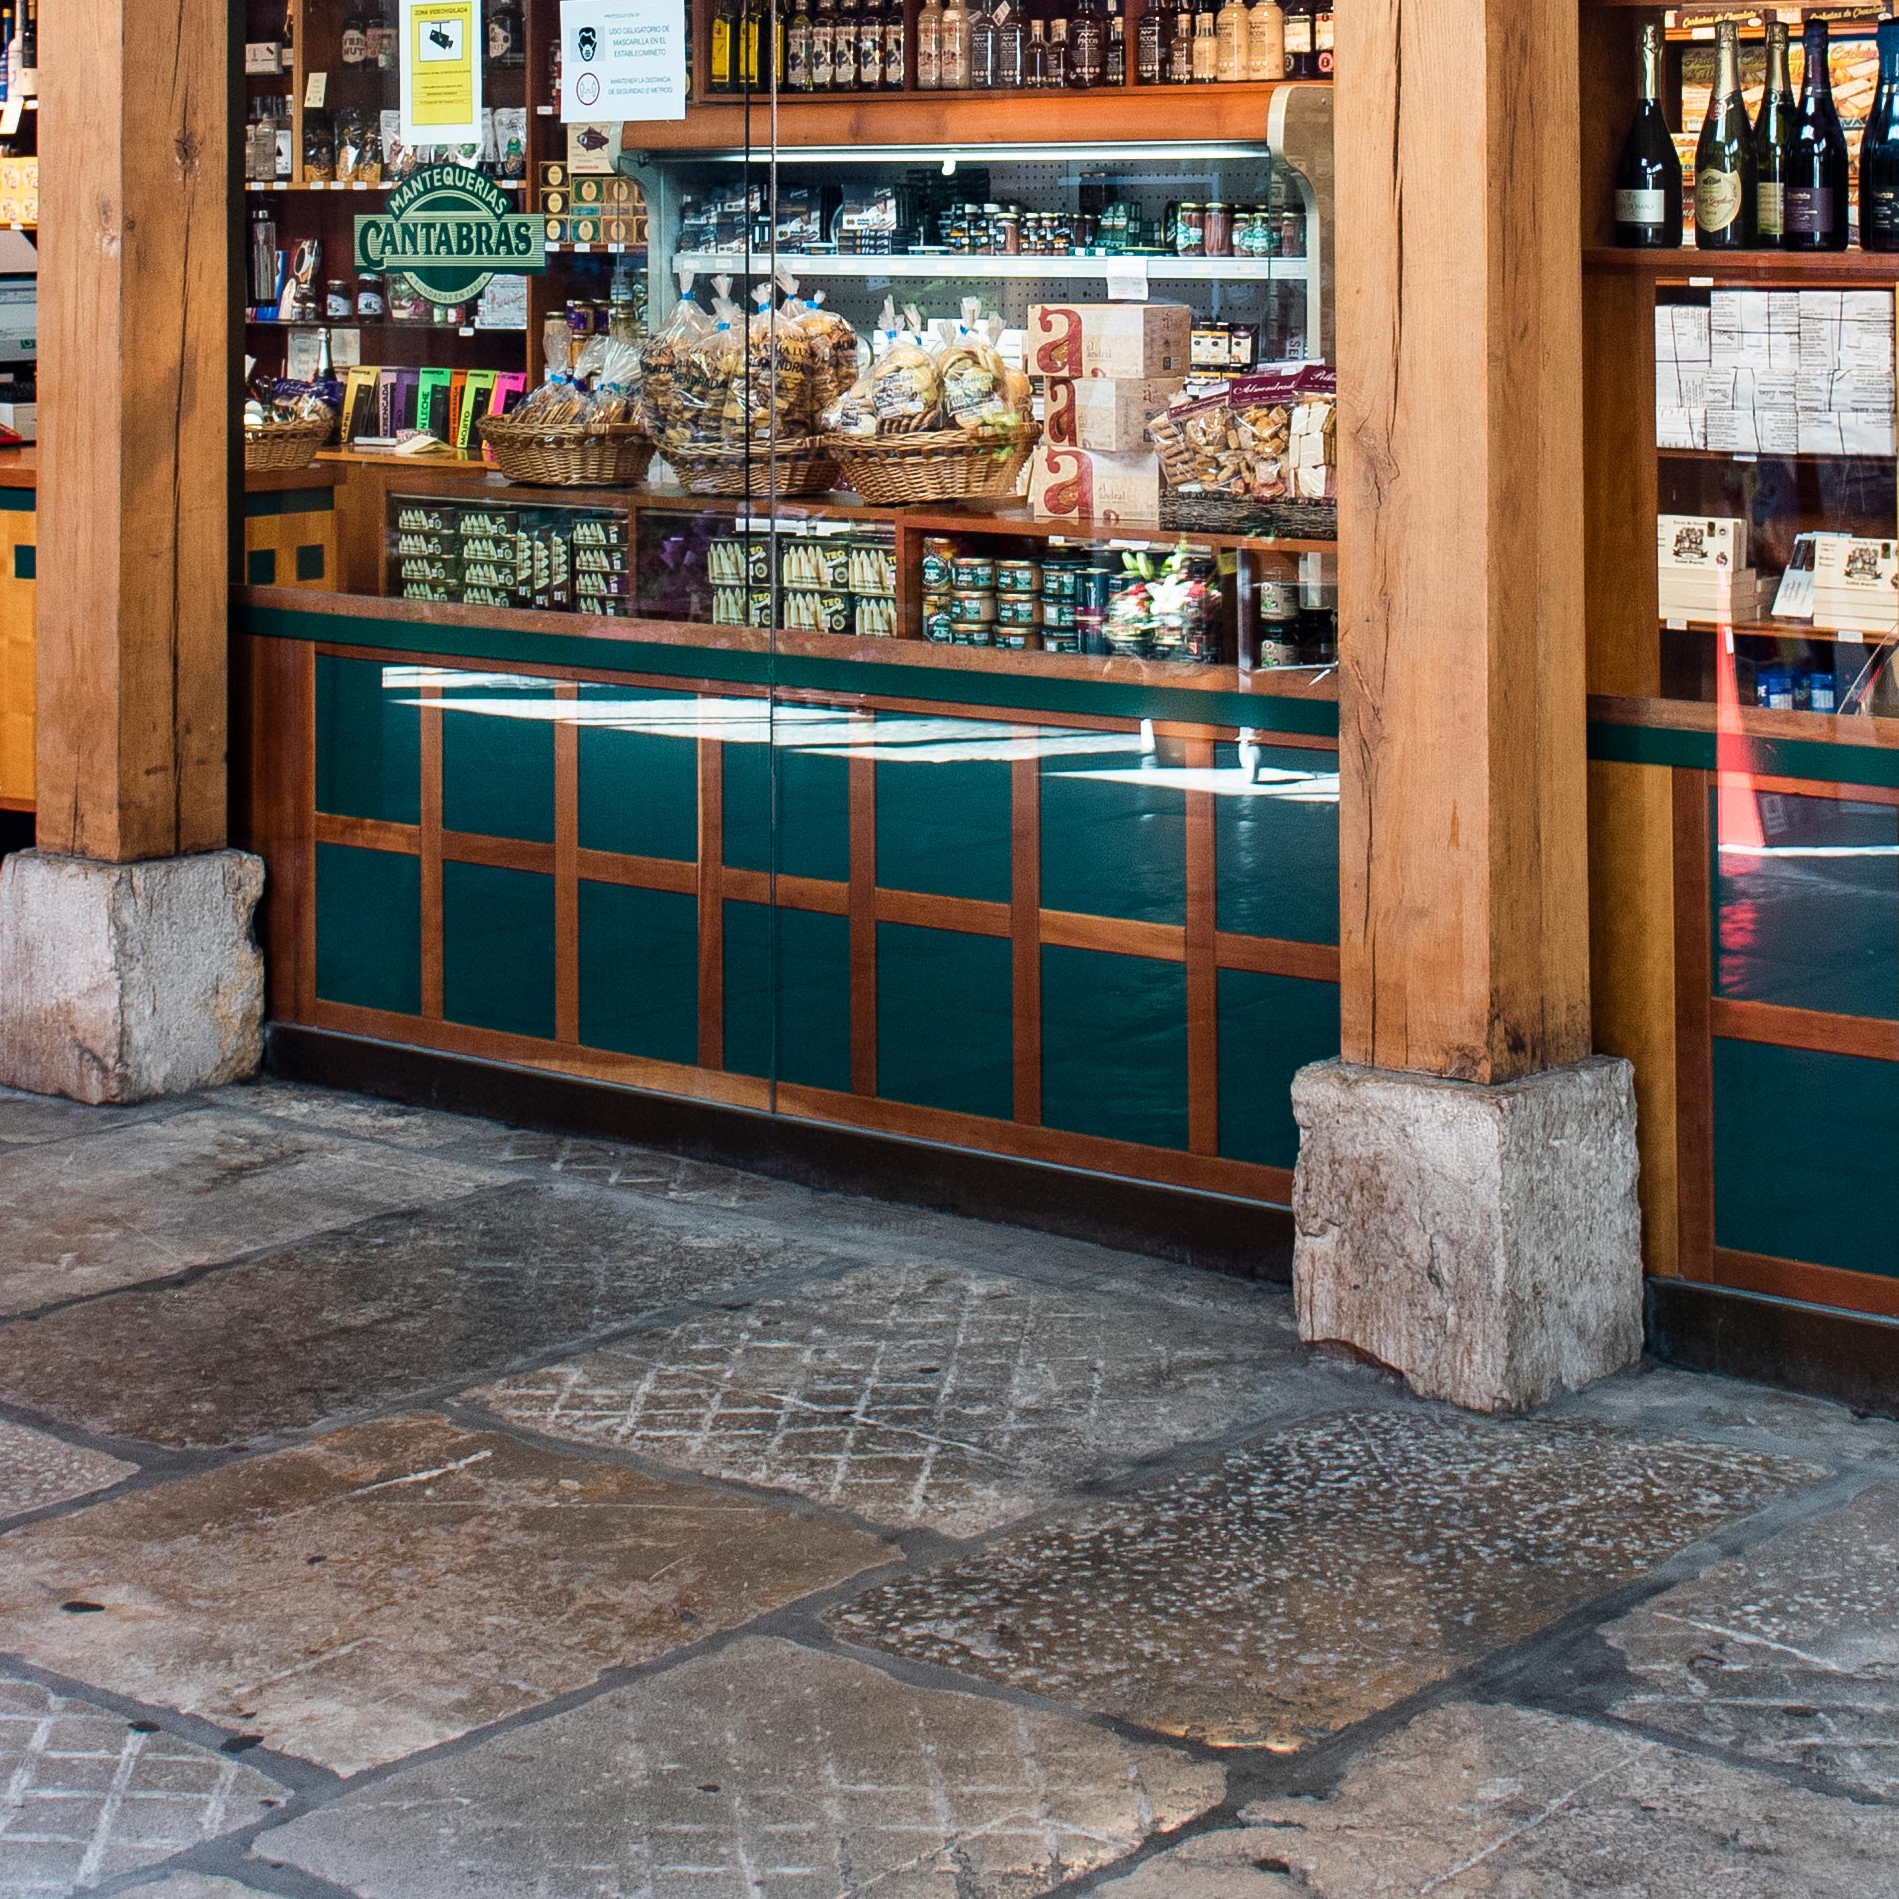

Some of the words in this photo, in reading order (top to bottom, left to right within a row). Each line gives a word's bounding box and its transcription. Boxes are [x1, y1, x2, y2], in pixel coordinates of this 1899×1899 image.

[608, 27, 622, 35] USO
[622, 25, 661, 35] OBLIGATORIO
[661, 25, 671, 33] DE
[613, 38, 649, 46] MASCARILLA
[650, 37, 659, 45] EN
[659, 37, 667, 45] EL
[1077, 37, 1100, 45] PICOS
[389, 166, 508, 216] MANTEQUERIAS
[358, 219, 532, 270] CANTABRAS
[414, 278, 453, 301] FUNDADAS
[454, 291, 465, 300] EN
[1036, 305, 1083, 377] a
[420, 391, 430, 417] LECHE
[460, 410, 471, 446] MOJITO
[1043, 448, 1094, 519] a
[825, 550, 846, 560] TEO
[822, 598, 842, 607] TEO
